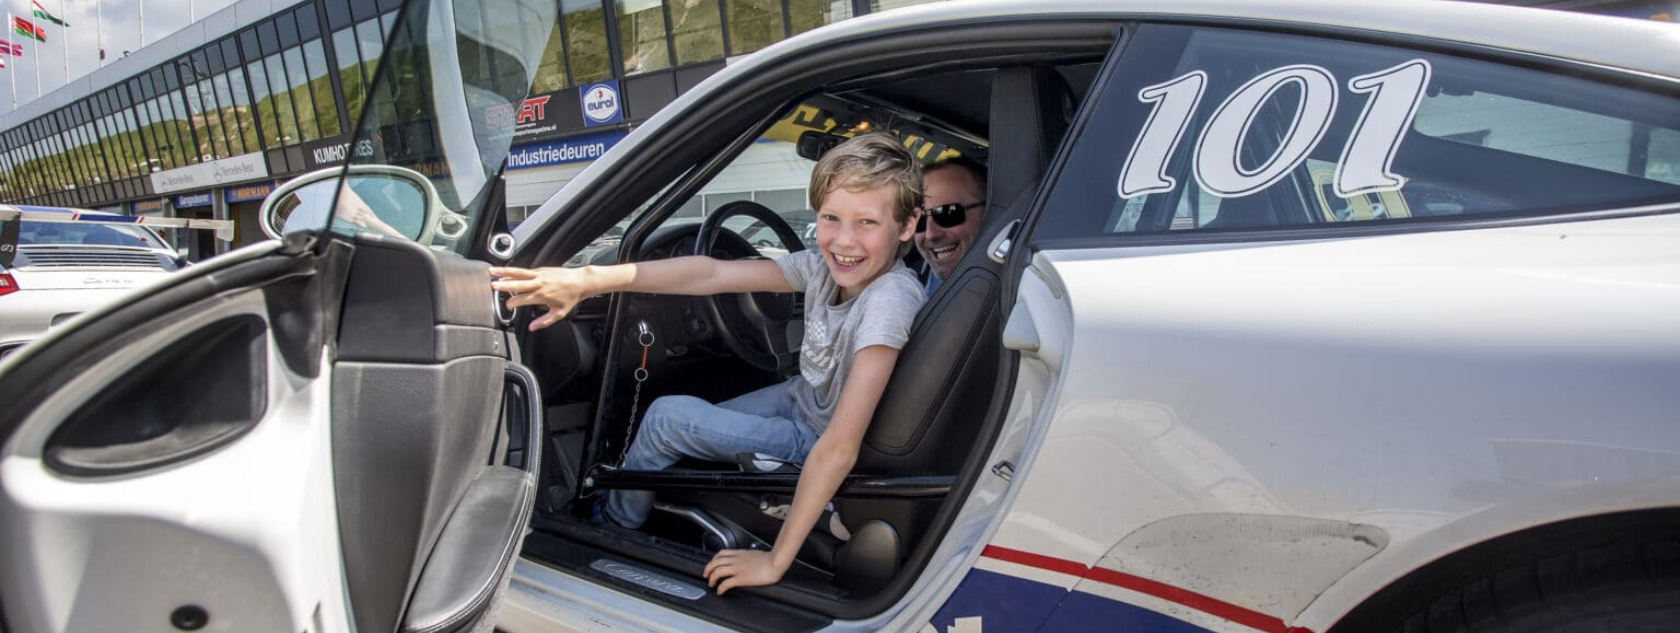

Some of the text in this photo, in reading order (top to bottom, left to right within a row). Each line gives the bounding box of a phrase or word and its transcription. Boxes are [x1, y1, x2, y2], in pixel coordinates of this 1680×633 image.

[588, 97, 614, 112] eurol
[1118, 59, 1431, 198] 101
[314, 140, 374, 164] KUMHO TRES
[508, 142, 605, 167] Industriedeuren
